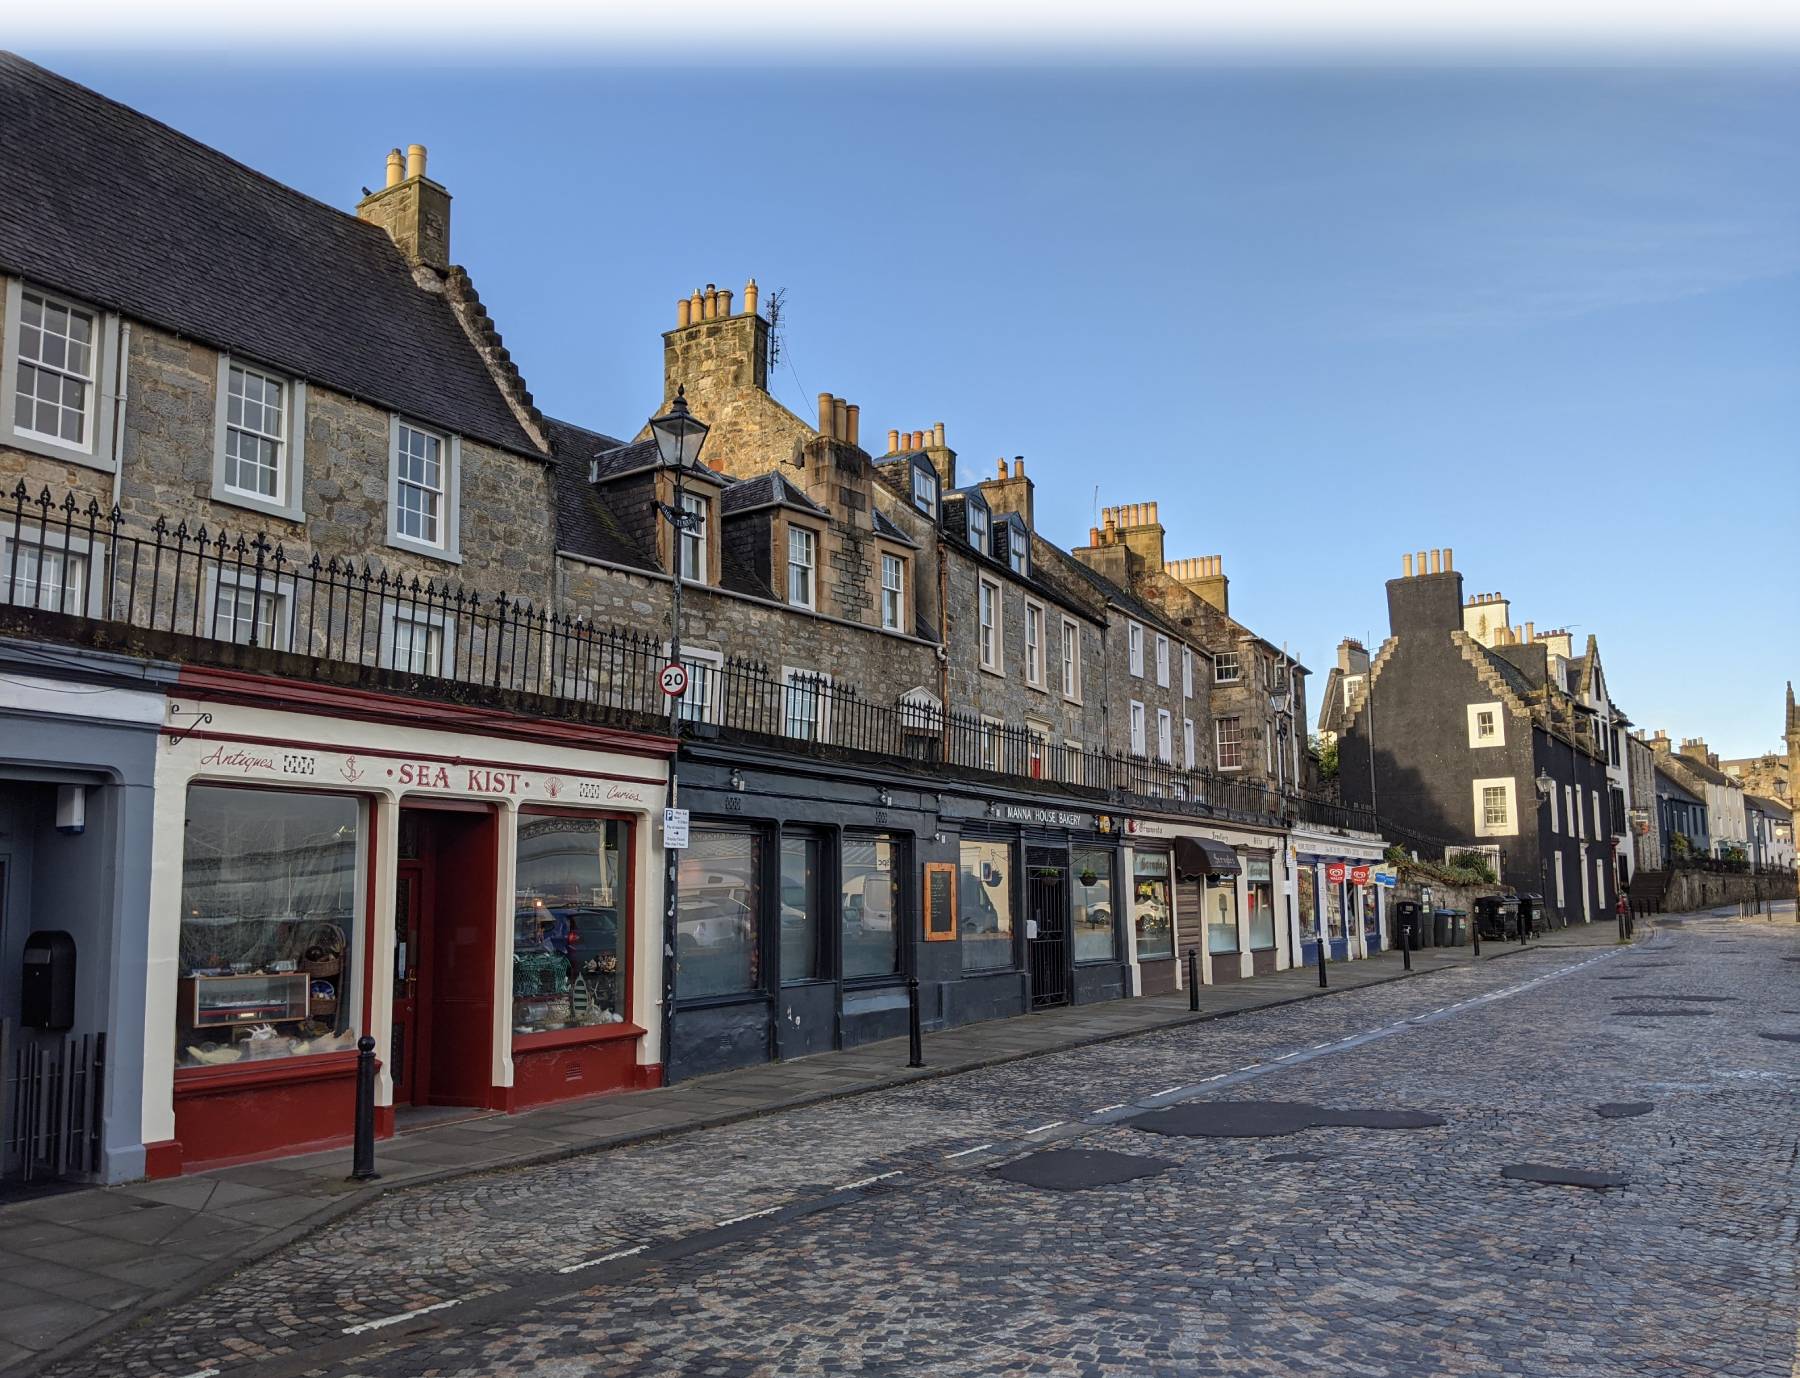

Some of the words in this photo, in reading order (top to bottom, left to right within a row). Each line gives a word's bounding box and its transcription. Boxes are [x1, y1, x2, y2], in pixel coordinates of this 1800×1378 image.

[663, 673, 684, 687] 20
[201, 745, 277, 772] Antiques
[398, 763, 451, 789] SEA
[467, 769, 521, 795] KIST
[606, 785, 642, 802] Curios
[1007, 806, 1032, 820] MANNA
[1035, 809, 1056, 823] HOUSE
[1059, 812, 1081, 826] BAKERY
